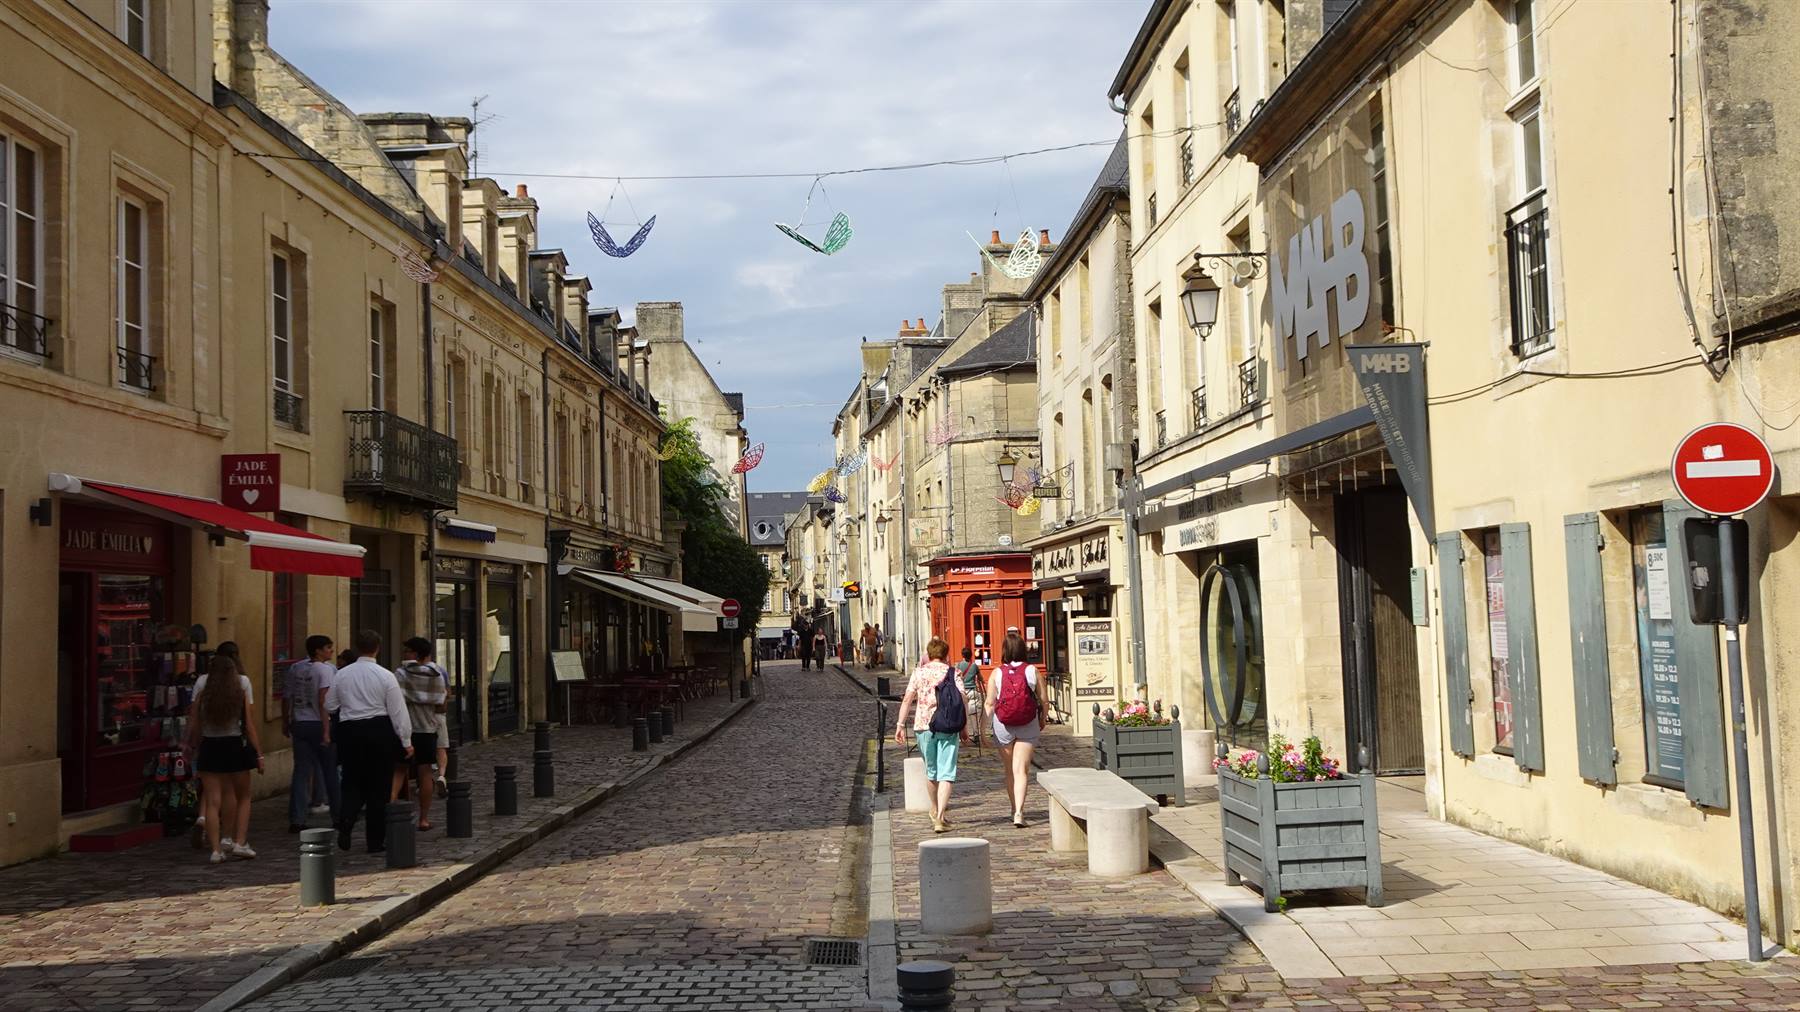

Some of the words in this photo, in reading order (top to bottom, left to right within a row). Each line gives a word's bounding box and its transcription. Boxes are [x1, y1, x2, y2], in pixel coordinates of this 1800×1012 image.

[1271, 189, 1370, 371] MAHB
[1361, 353, 1411, 373] MAHB
[235, 461, 268, 471] JADE
[229, 474, 274, 485] ÉMILIA
[65, 529, 97, 549] JADE
[101, 528, 142, 553] ÉMILIA
